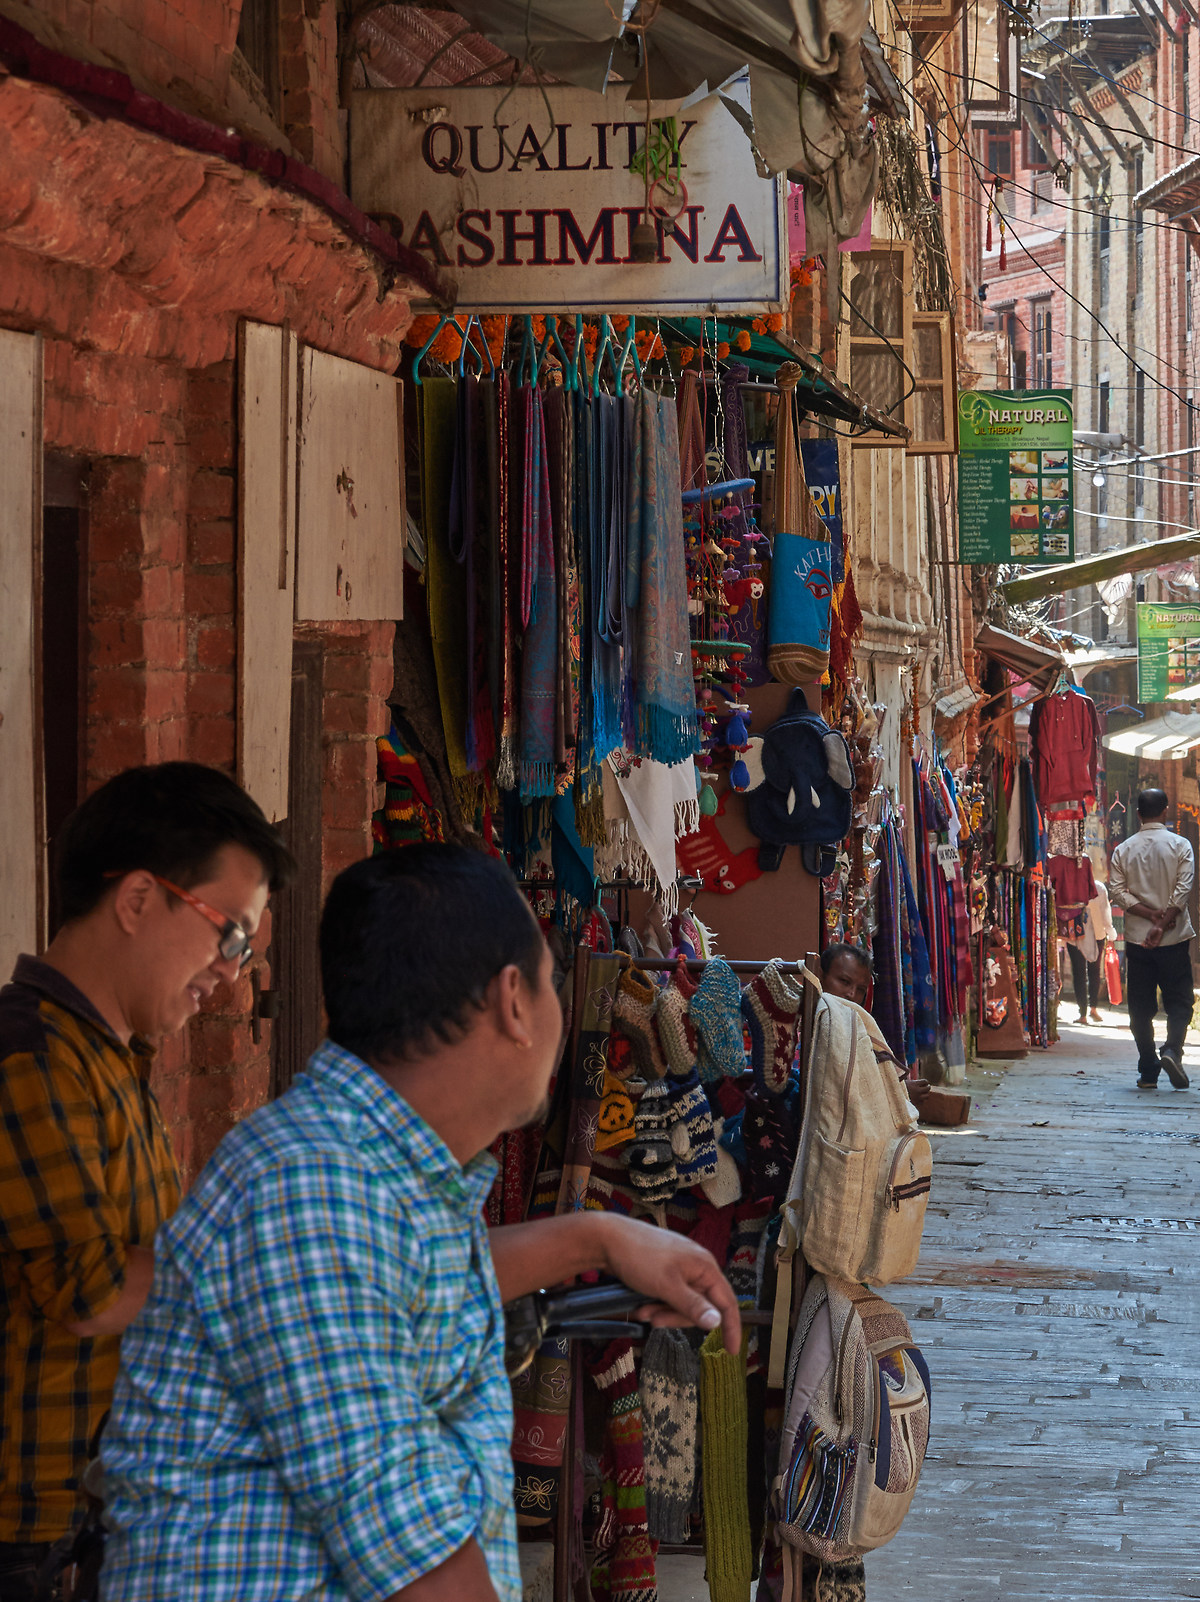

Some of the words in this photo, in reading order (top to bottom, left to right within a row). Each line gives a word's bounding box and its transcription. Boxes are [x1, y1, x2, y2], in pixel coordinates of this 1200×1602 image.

[421, 120, 698, 178] QUALITY
[989, 409, 1068, 425] NATURAL
[987, 427, 1023, 435] THERAPY
